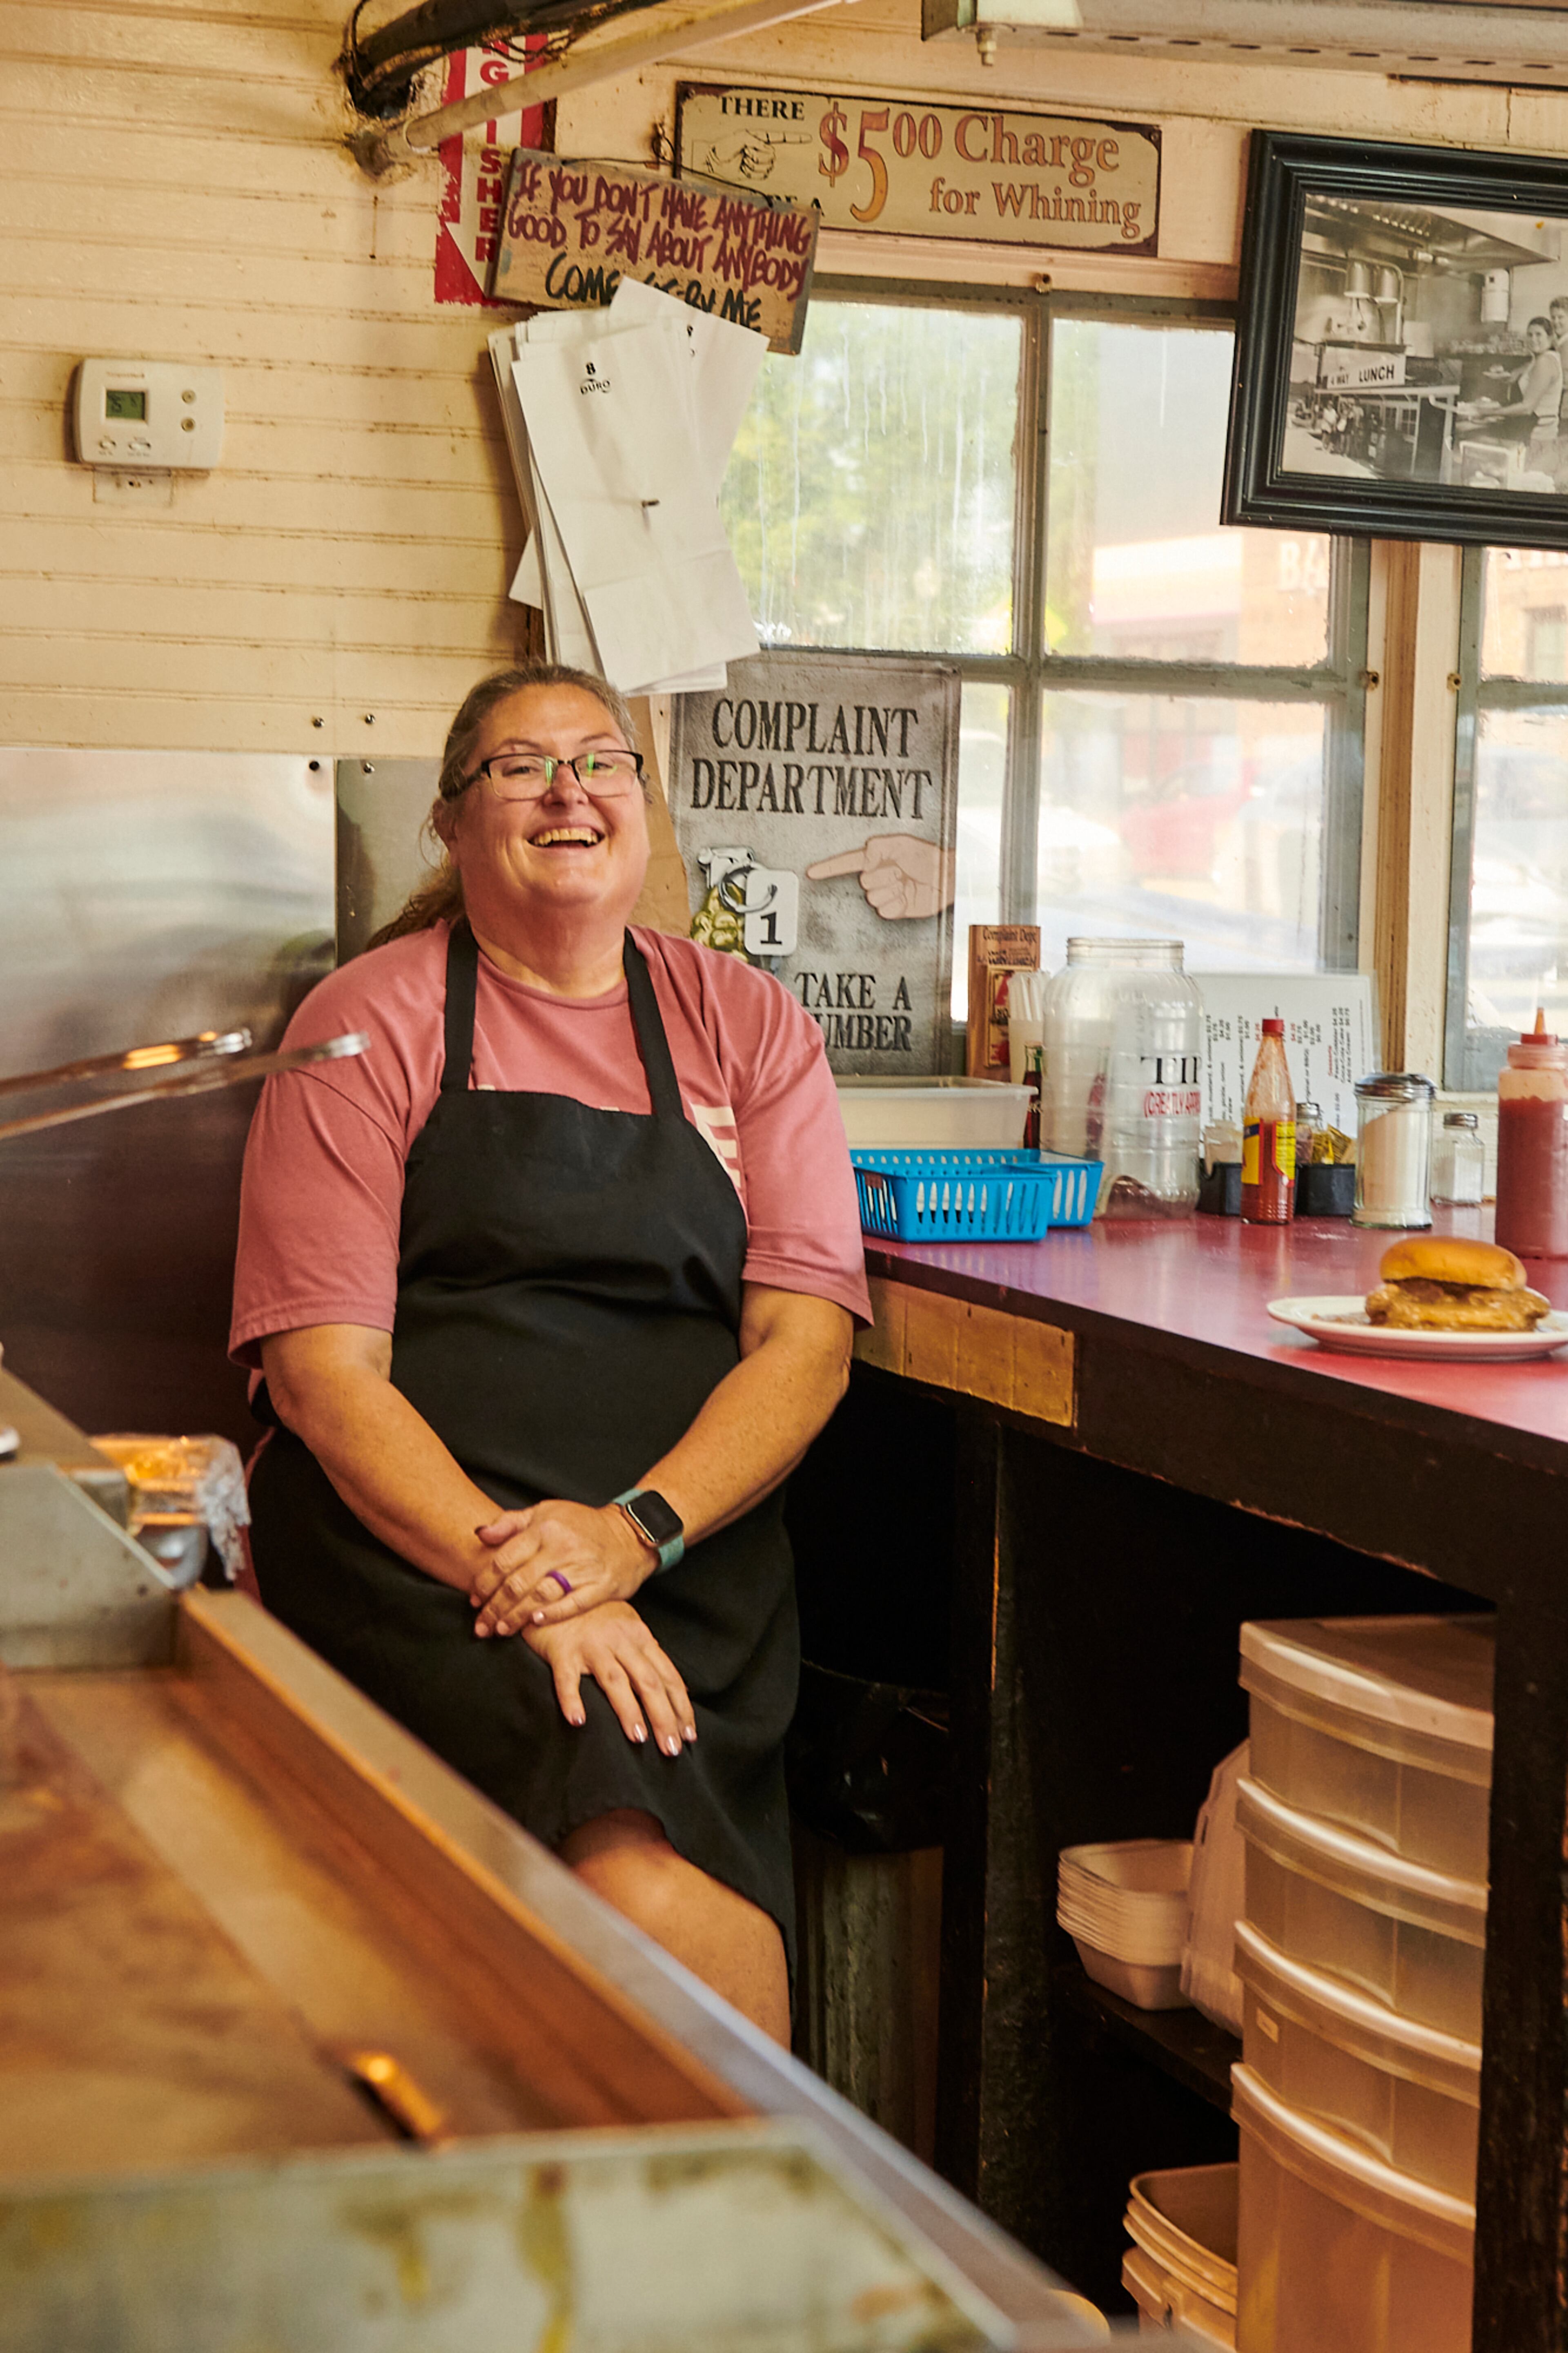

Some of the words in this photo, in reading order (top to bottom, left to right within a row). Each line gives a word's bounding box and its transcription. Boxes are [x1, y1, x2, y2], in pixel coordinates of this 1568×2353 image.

[720, 96, 805, 120] THERE
[954, 114, 1120, 188] Charge
[515, 159, 542, 202] IF
[549, 166, 588, 215] YOU
[661, 183, 708, 233] HAVE
[712, 194, 812, 256] ANYTHING
[929, 176, 981, 216] for
[991, 181, 1142, 240] Whining
[508, 198, 567, 249] GOOD
[573, 207, 601, 250] TO
[605, 214, 643, 267] SAY
[645, 221, 714, 274] ABOUT
[712, 238, 811, 302] ANYBODY
[546, 252, 620, 306] COME
[719, 288, 762, 333] ME
[579, 378, 610, 395] DURO
[1359, 364, 1394, 383] LUNCH
[712, 698, 919, 757] COMPLAINT
[690, 758, 933, 819] DEPARTMENT
[760, 912, 783, 945] 1
[794, 971, 877, 1010] TAKE
[892, 976, 912, 1011] A
[810, 1013, 912, 1052] UMBER
